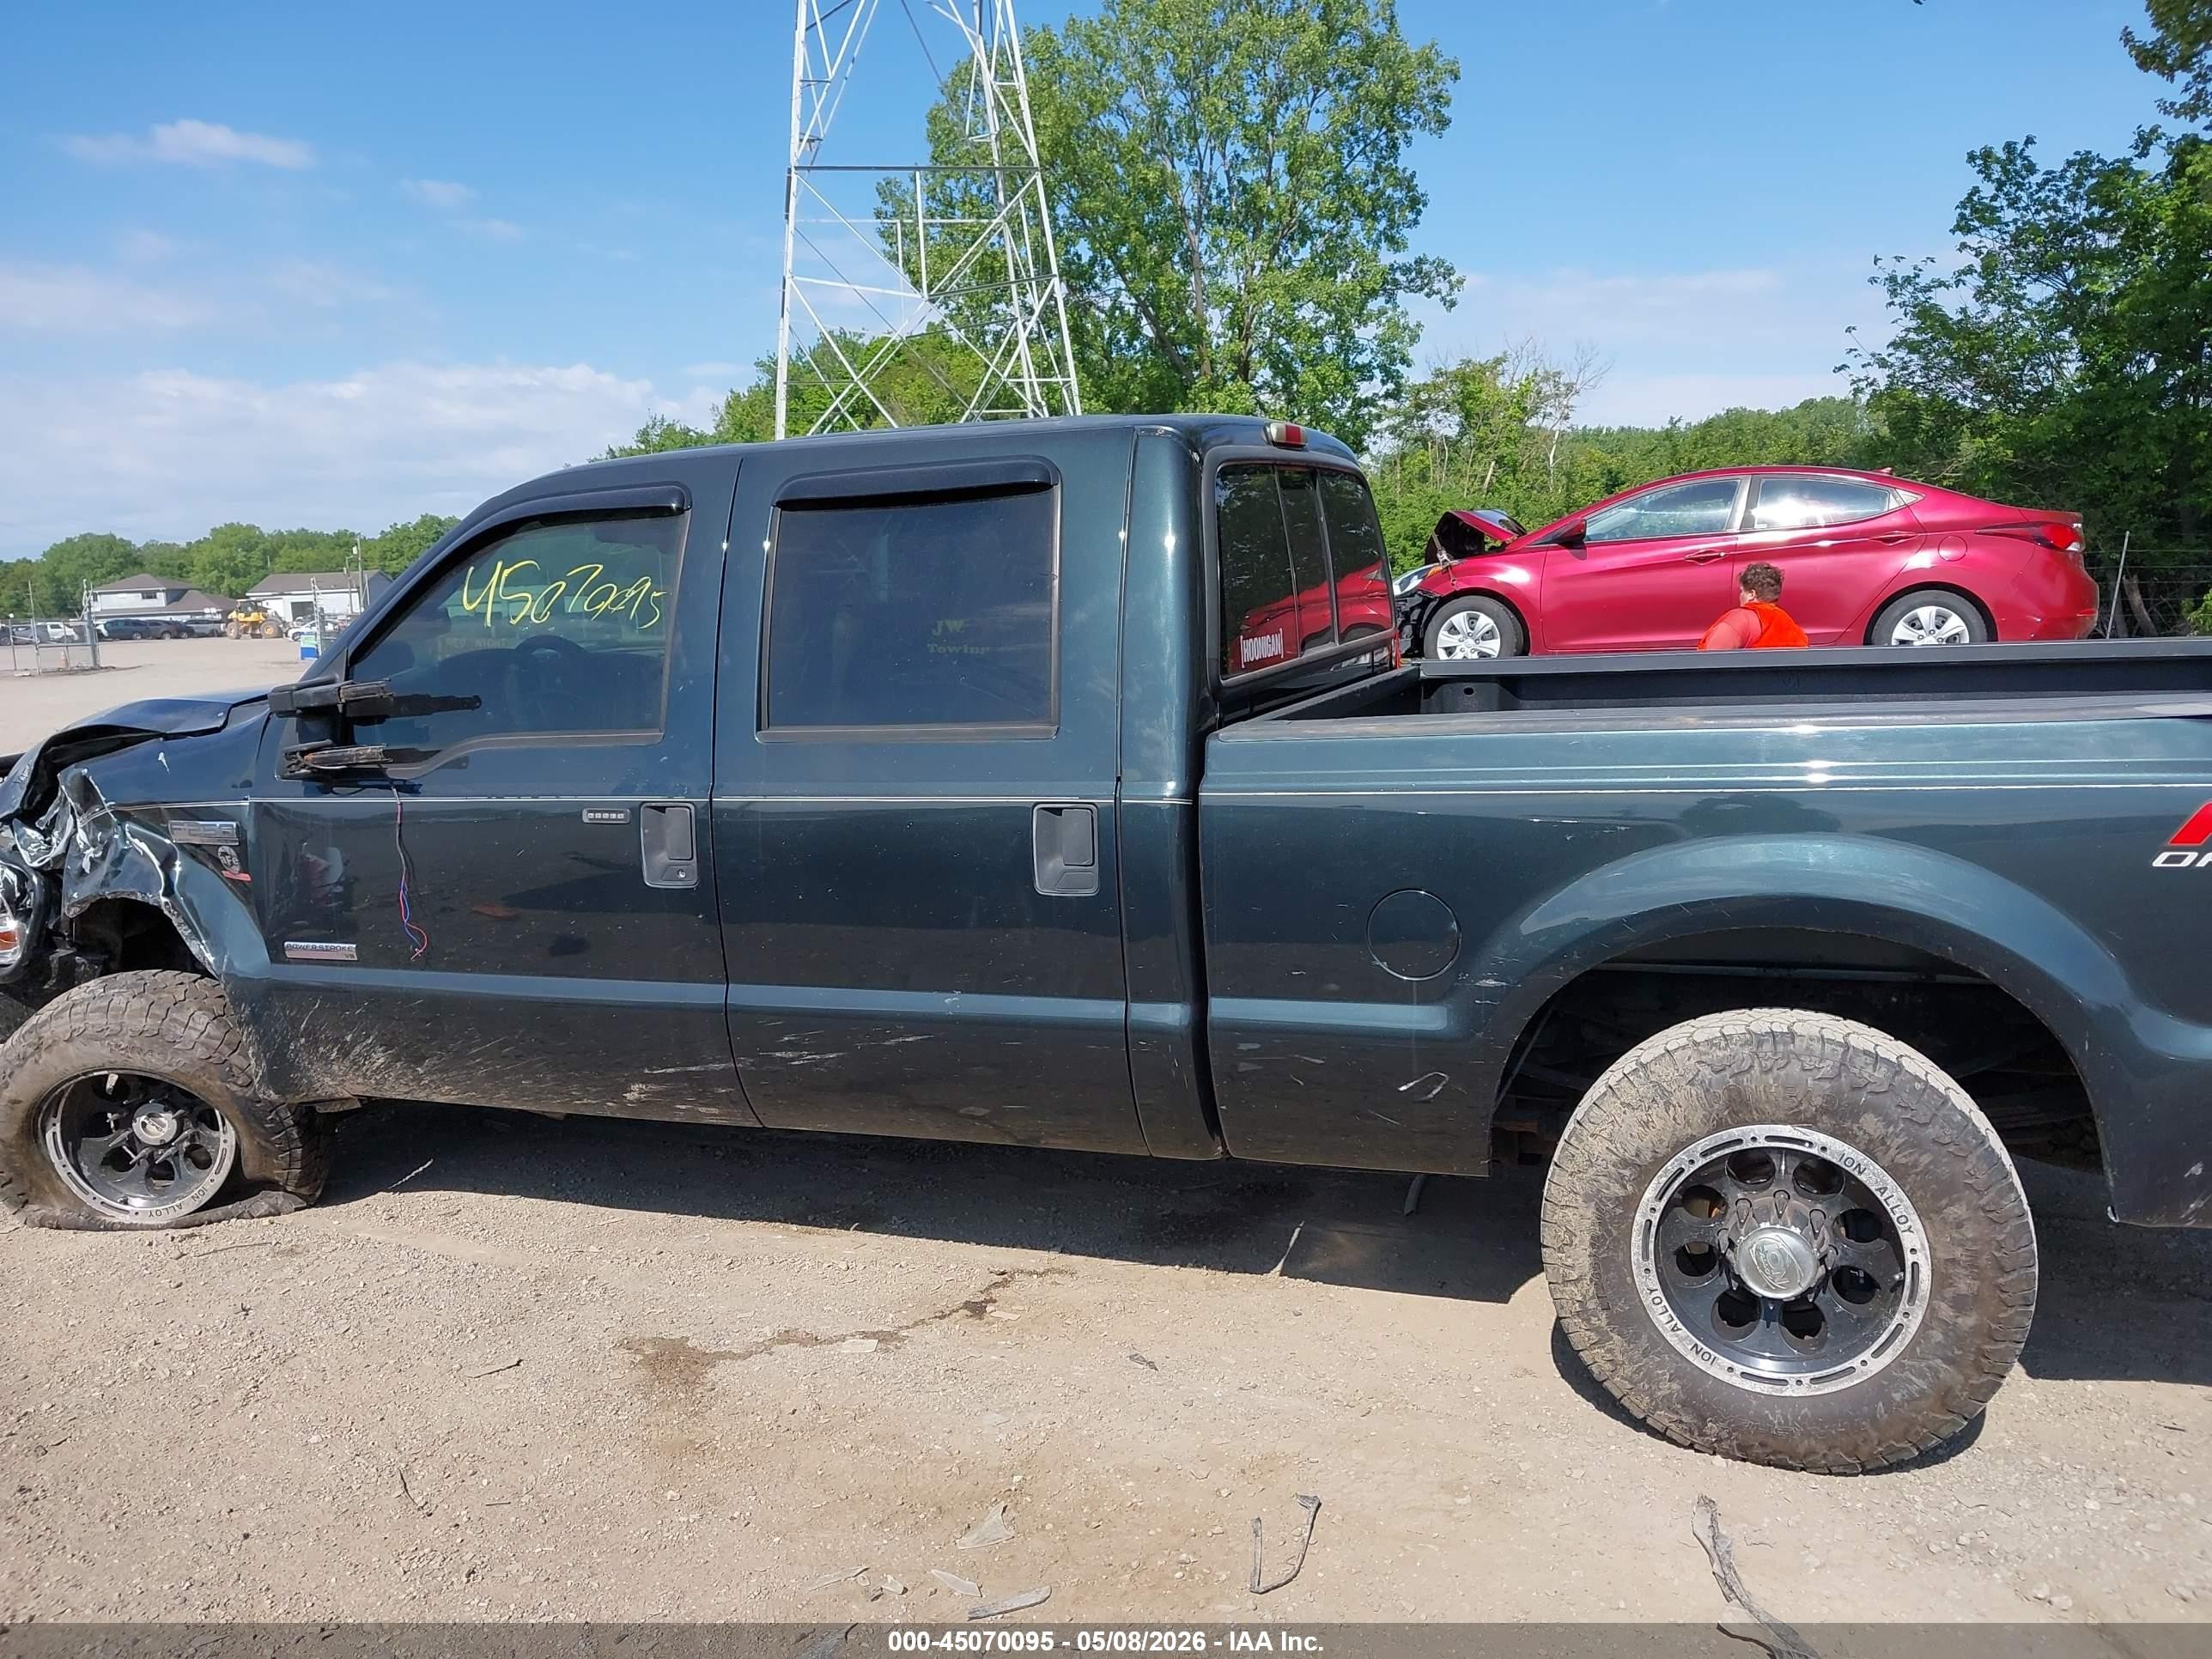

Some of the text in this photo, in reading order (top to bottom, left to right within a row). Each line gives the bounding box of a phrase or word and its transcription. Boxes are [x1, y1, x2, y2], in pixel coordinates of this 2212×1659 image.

[148, 1186, 208, 1218] ION ALLOY
[1838, 1152, 1915, 1236] ION ALLOY
[1645, 1288, 1718, 1365] ION ALLOY
